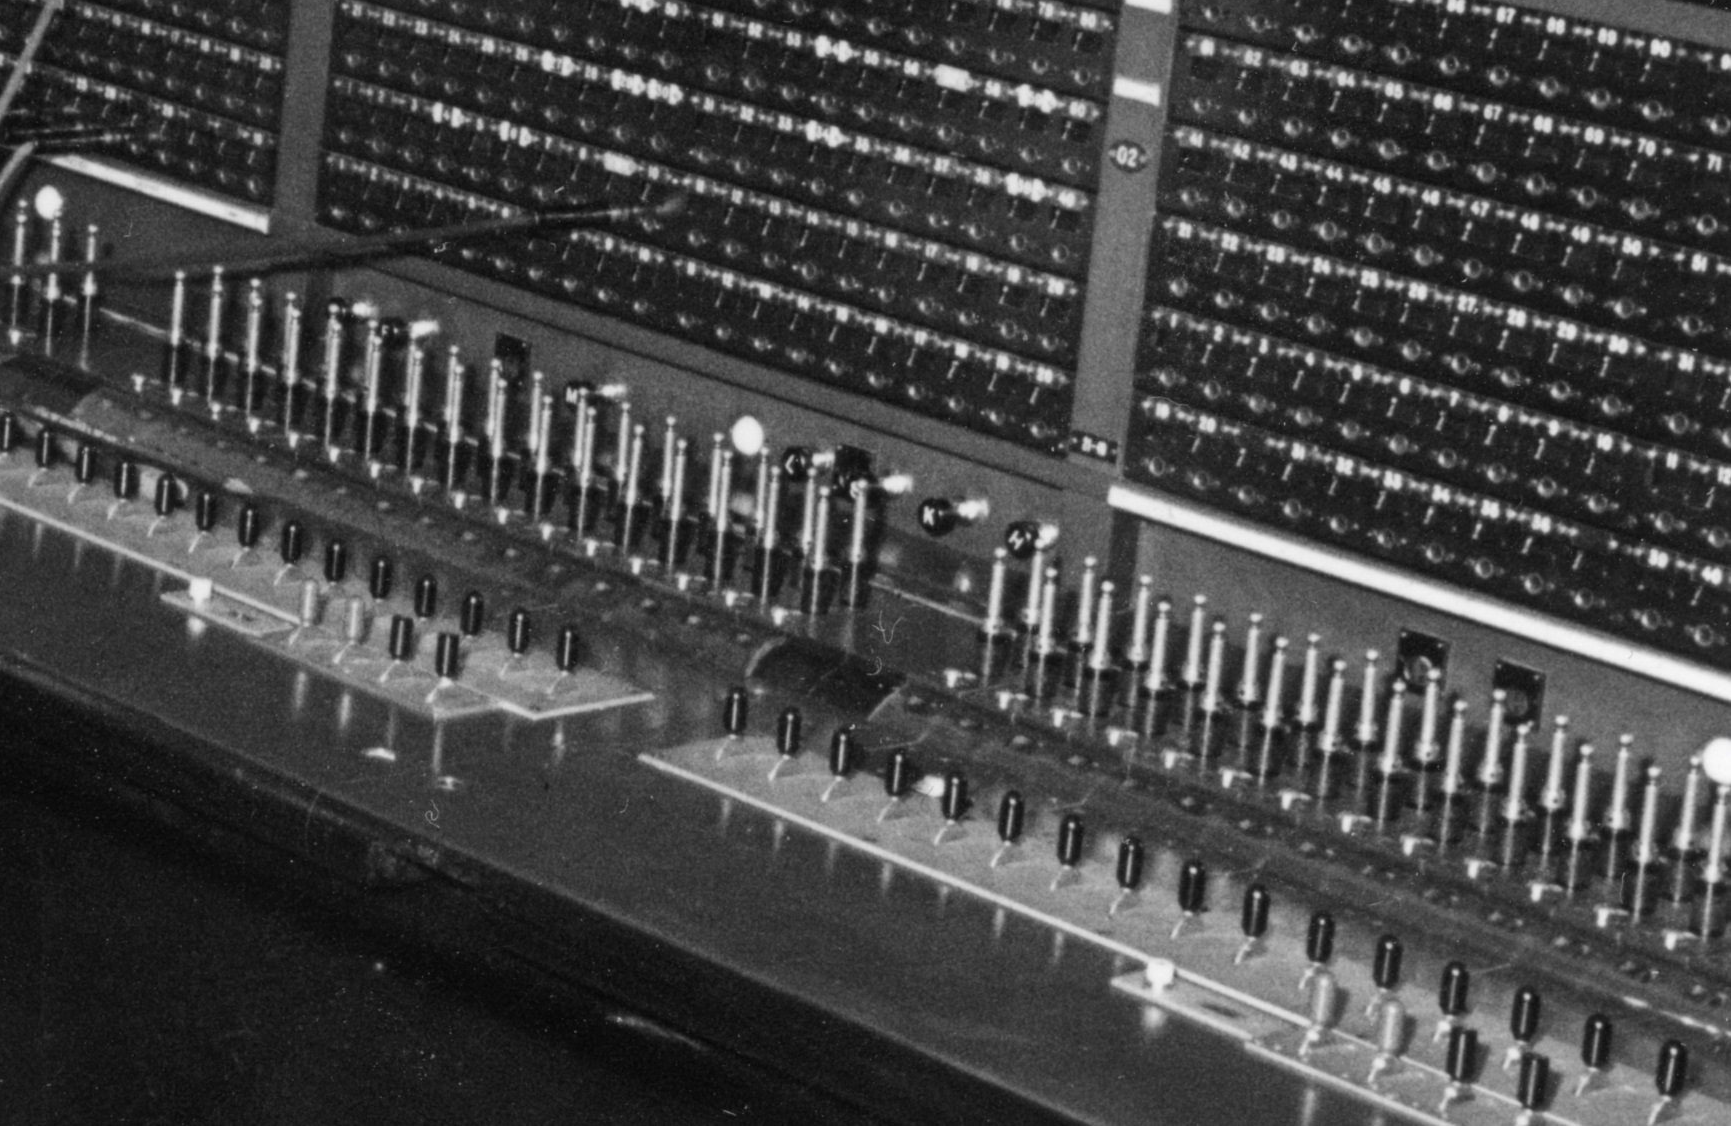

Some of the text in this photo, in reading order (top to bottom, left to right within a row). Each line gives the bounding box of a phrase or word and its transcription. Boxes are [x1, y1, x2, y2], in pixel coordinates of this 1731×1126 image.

[1497, 7, 1515, 23] 87
[1547, 17, 1565, 34] 88
[1598, 28, 1617, 45] 89
[1651, 39, 1671, 57] 90
[1200, 39, 1722, 171] 61 62 63 64 65 66 67 68 69 70 71
[1114, 146, 1138, 167] 02
[1189, 131, 1707, 271] 41 42 43 44 45 46 47 48 49 50 51
[1178, 222, 1694, 371] 21 22 23 24 25 26 27 28 29 30 31
[566, 388, 580, 403] M
[1597, 434, 1613, 451] 10
[1667, 452, 1678, 469] 11
[924, 507, 934, 525] K
